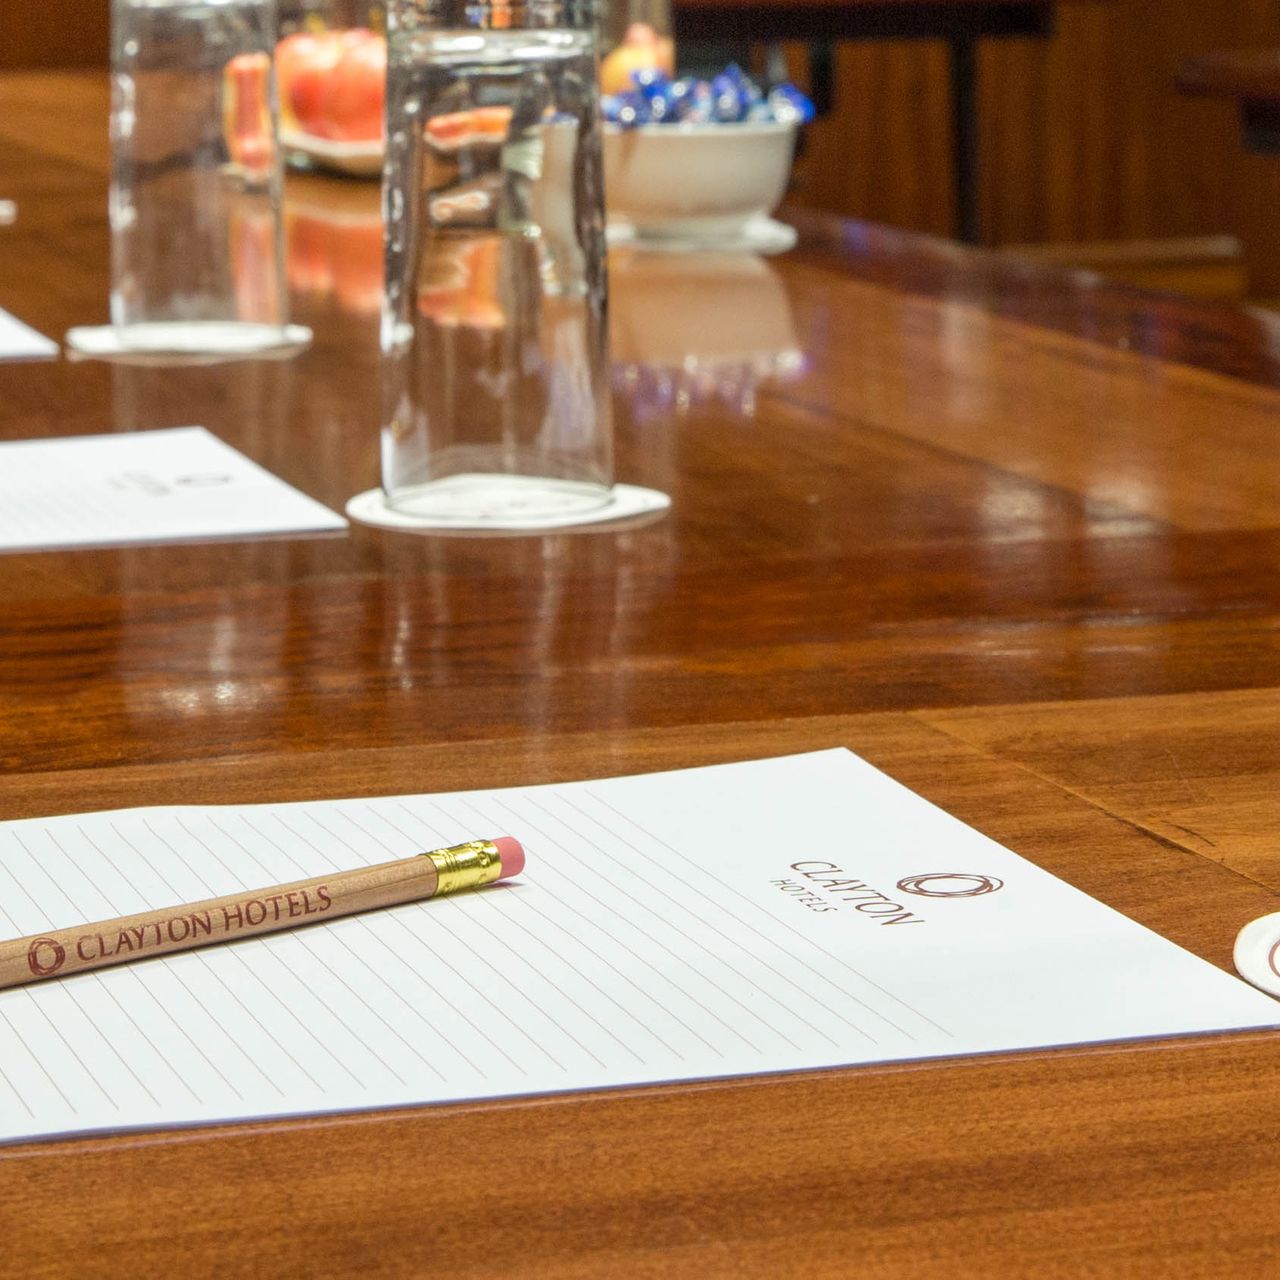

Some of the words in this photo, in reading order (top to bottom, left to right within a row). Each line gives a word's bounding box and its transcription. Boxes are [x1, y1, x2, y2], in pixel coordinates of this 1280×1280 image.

[76, 910, 213, 961] CLAYTON
[223, 884, 333, 932] HOTELS
[769, 877, 838, 913] HOTELS
[790, 860, 925, 926] CLAYTON
